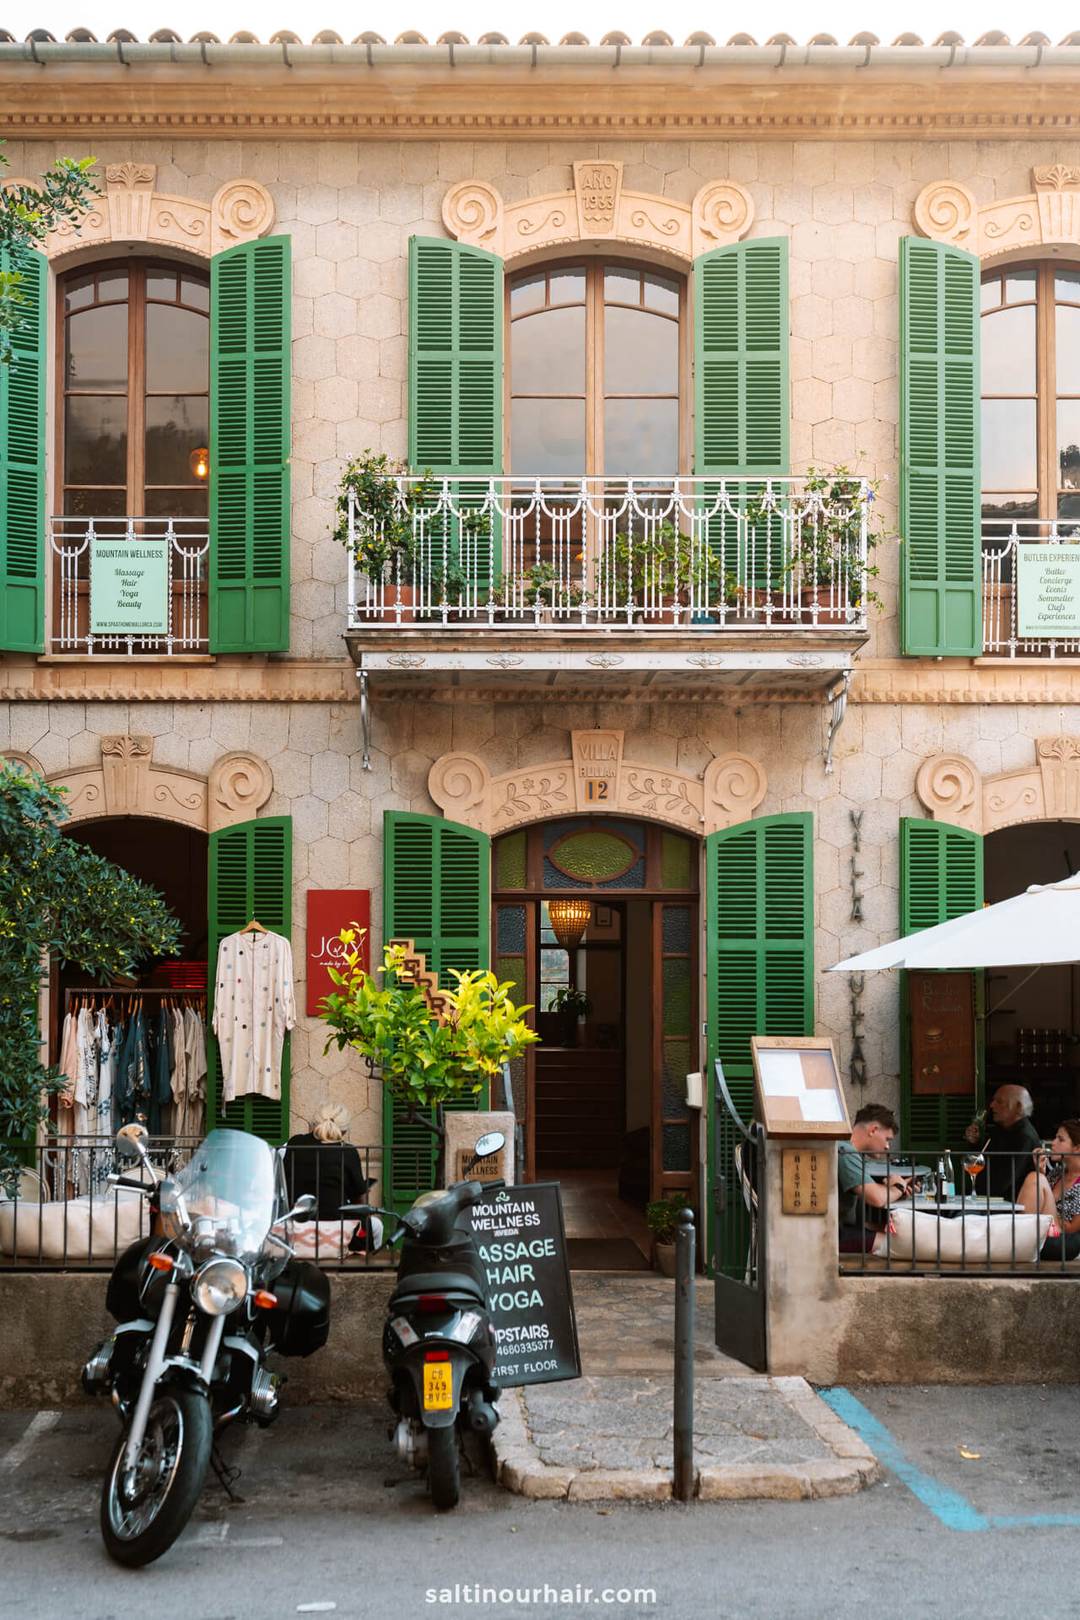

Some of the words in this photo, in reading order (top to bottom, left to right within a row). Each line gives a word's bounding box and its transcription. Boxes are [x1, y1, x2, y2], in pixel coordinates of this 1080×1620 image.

[96, 550, 128, 558] MOUNTAIN
[130, 550, 163, 558] WELLNESS
[1023, 553, 1048, 562] BUTLER
[114, 568, 144, 578] Massage
[121, 579, 137, 587] Hair
[1040, 577, 1072, 586] Concierge
[120, 589, 139, 599] Yoga
[1045, 585, 1067, 593] Events
[117, 600, 142, 609] Beauty
[1047, 603, 1066, 613] Chefs
[1038, 612, 1076, 622] Experiences
[579, 743, 618, 760] VILLA
[588, 781, 608, 800] 12
[472, 1201, 535, 1217] MOUNTAIN
[471, 1213, 541, 1231] WELLNESS
[478, 1238, 556, 1263] ASSAGE
[486, 1263, 536, 1286] HAIR
[489, 1289, 544, 1312] YOGA
[491, 1364, 520, 1377] FIRST
[523, 1360, 558, 1373] FLOOR
